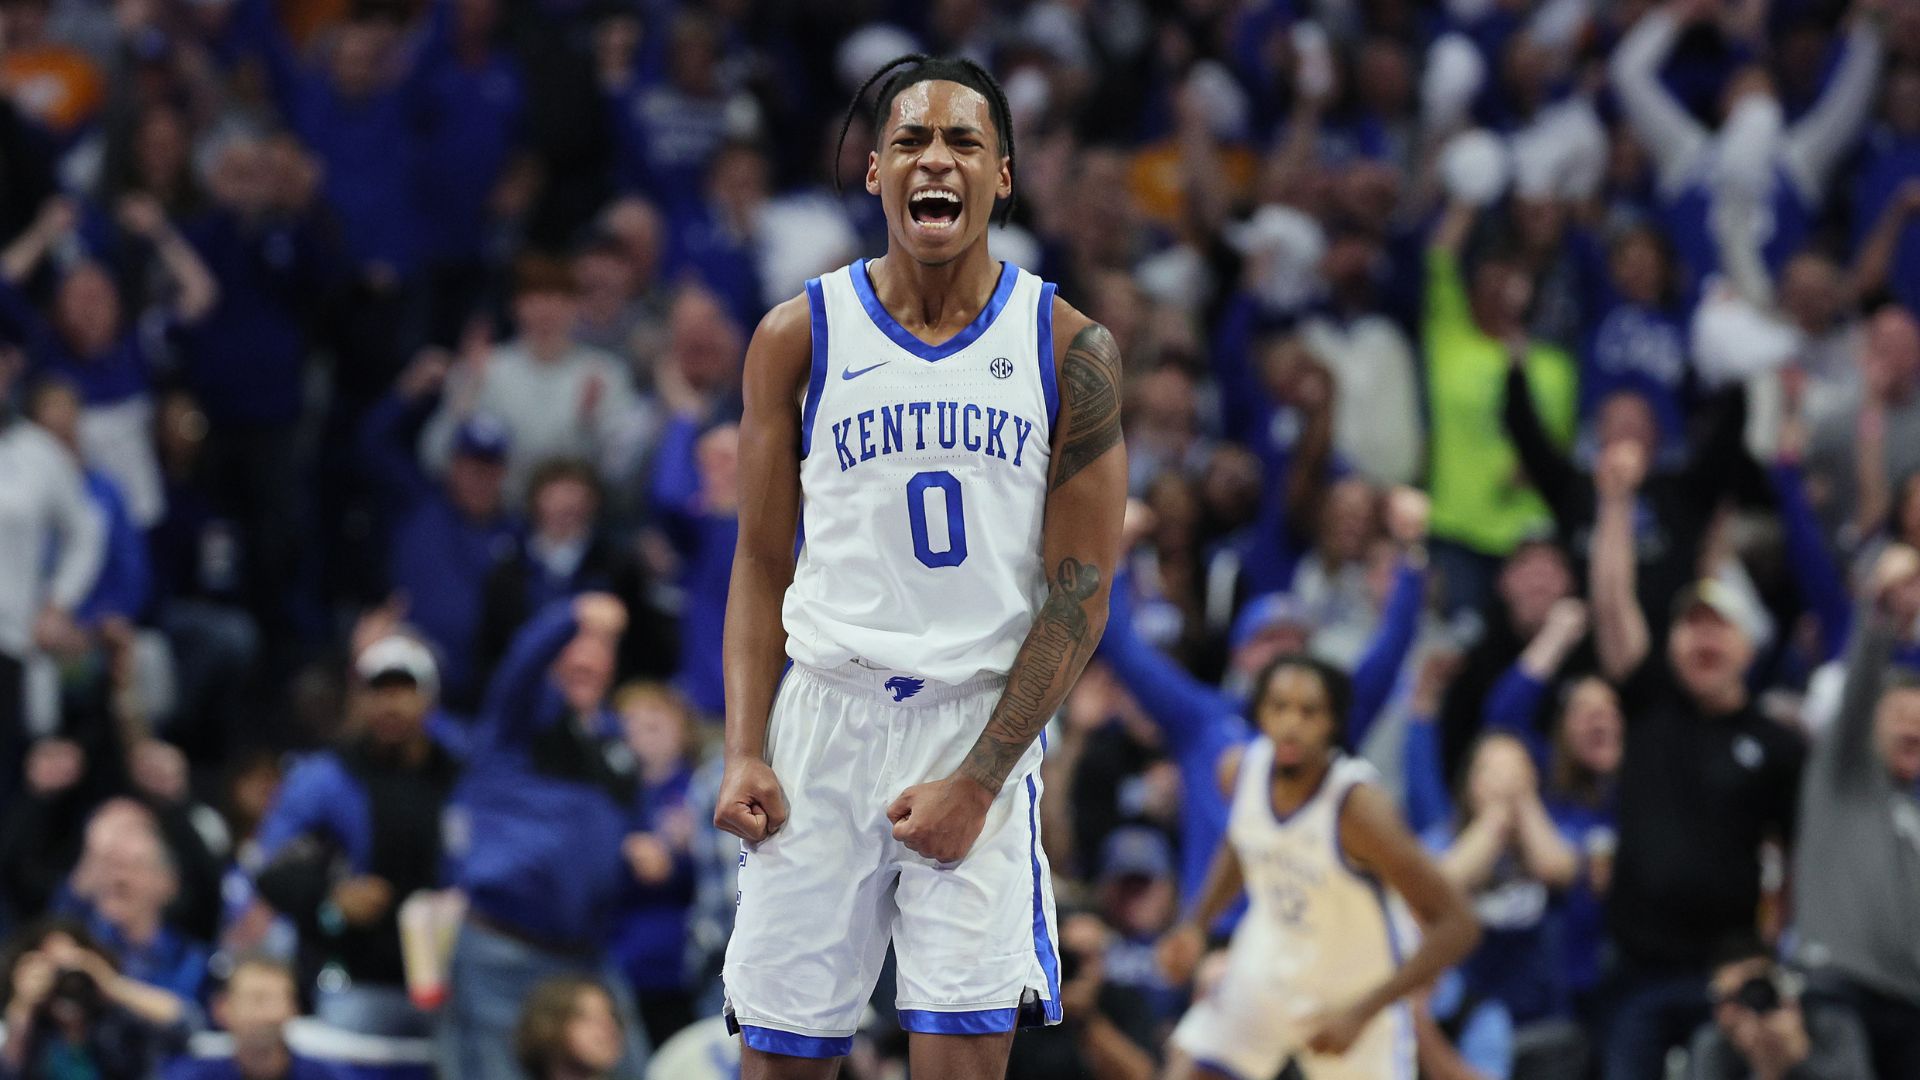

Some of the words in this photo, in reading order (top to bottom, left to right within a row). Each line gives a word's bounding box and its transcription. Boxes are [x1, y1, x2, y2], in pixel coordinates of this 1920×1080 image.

[990, 357, 1013, 379] SEC
[832, 402, 1032, 472] KENTUCKY
[906, 471, 968, 568] 0
